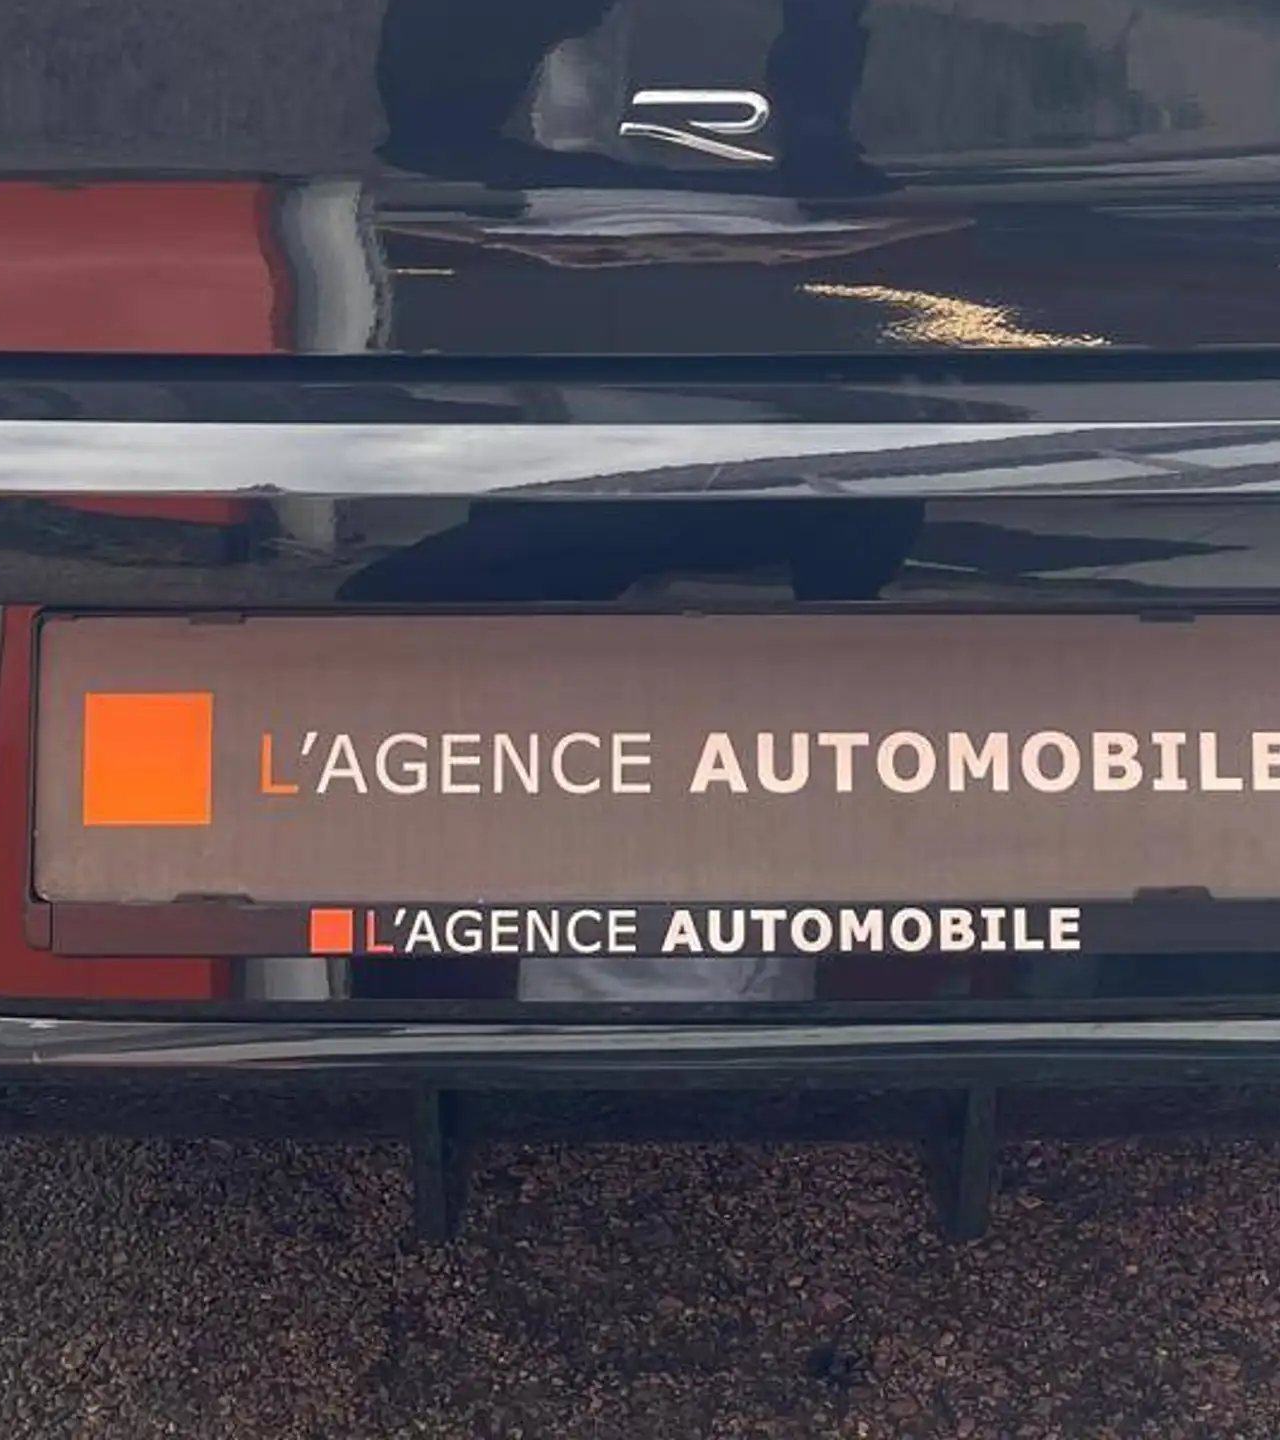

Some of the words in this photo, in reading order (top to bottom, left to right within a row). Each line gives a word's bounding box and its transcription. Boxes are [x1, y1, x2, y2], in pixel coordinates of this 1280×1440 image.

[619, 89, 775, 162] R
[260, 730, 652, 796] L'AGENCE
[365, 907, 638, 955] L'AGENCE
[660, 907, 1082, 953] AUTOMOBILE
